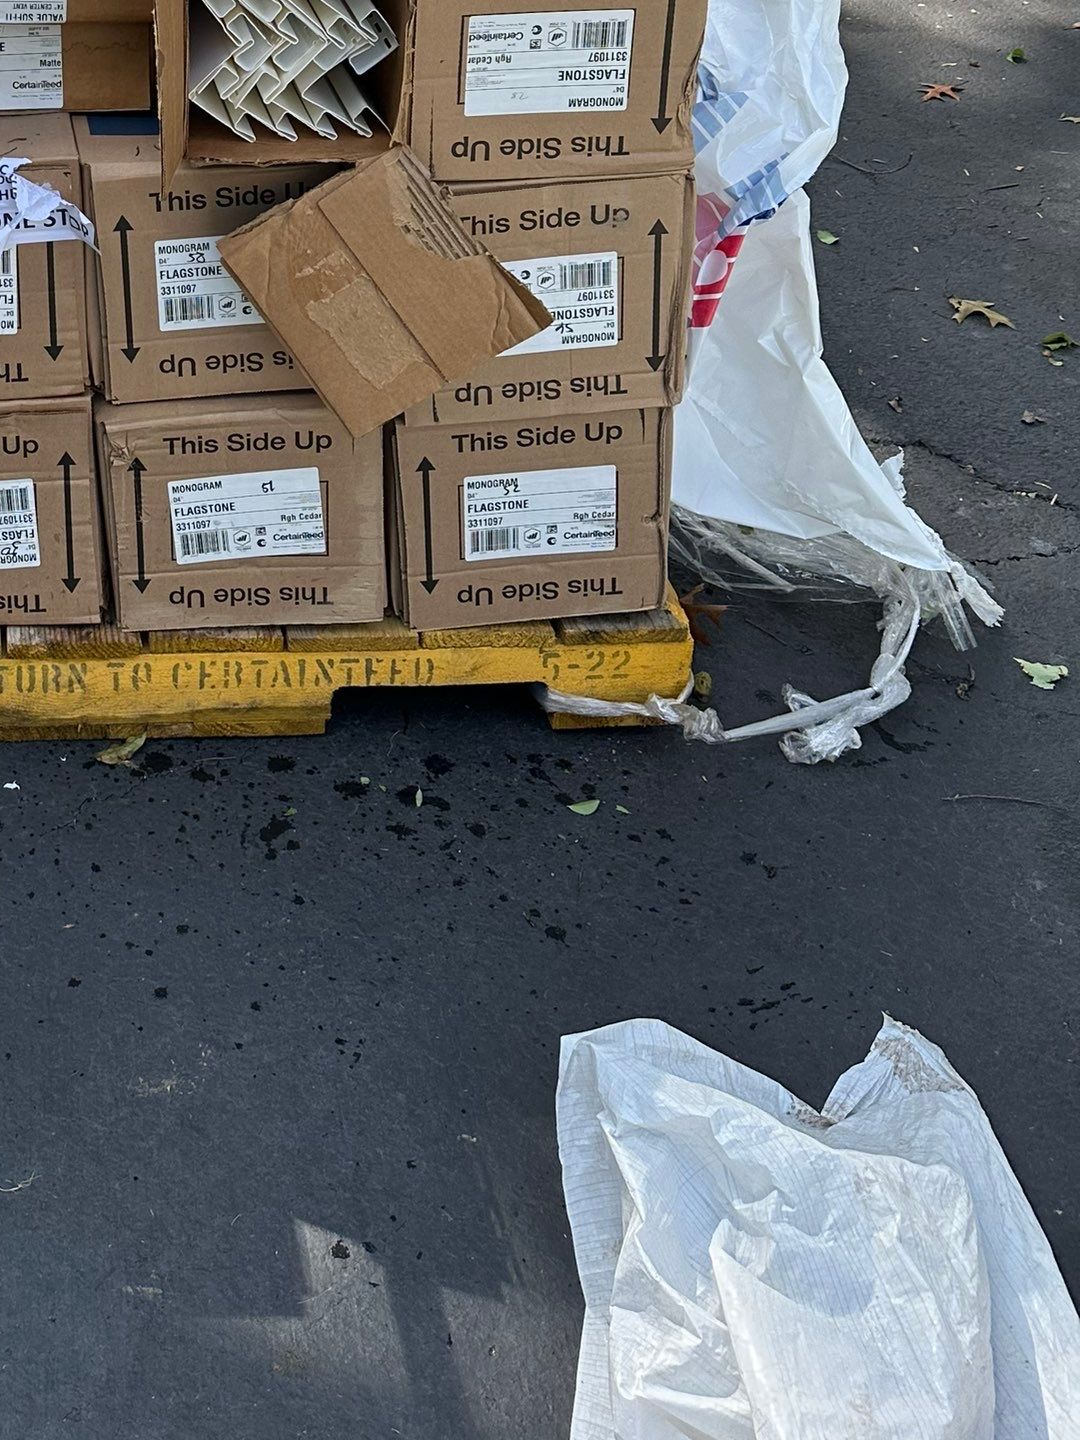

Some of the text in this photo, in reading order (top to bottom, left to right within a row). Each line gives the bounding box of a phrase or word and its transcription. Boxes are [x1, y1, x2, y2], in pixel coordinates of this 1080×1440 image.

[468, 32, 524, 42] CertainTeed
[39, 59, 61, 67] Matte
[468, 52, 627, 63] 3311097 Rgh Cedar
[558, 70, 626, 80] FLAGSTONE
[12, 80, 61, 90] CertainTeed
[568, 97, 623, 107] MONOGRAM
[451, 136, 629, 161] This Side Up
[149, 185, 275, 212] This Side
[519, 208, 580, 230] Side
[158, 242, 210, 254] MONOGRAM
[160, 266, 222, 280] FLAGSTONE
[160, 284, 196, 296] 3311097
[577, 289, 614, 302] 3311097
[562, 331, 614, 344] MONOGRAM
[159, 351, 294, 377] is Side Up
[455, 374, 628, 406] This Side Up
[163, 431, 332, 455] This Side Up
[451, 422, 623, 452] This Side Up
[3, 436, 38, 458] Up
[172, 481, 222, 493] MONOGRAM
[467, 477, 518, 489] MONOGRAM
[174, 502, 236, 517] FLAGSTONE
[468, 500, 529, 513] FLAGSTONE
[0, 514, 33, 525] 3311097
[176, 512, 322, 531] 3311097 Rgh Cedar
[468, 510, 615, 528] 3311097 Rgh Cedar
[273, 531, 323, 541] CertainTeed
[564, 529, 614, 540] CertainTeed
[170, 587, 334, 608] This Side Up
[457, 577, 623, 606] This Side Up
[171, 657, 435, 690] CERTAINTEED
